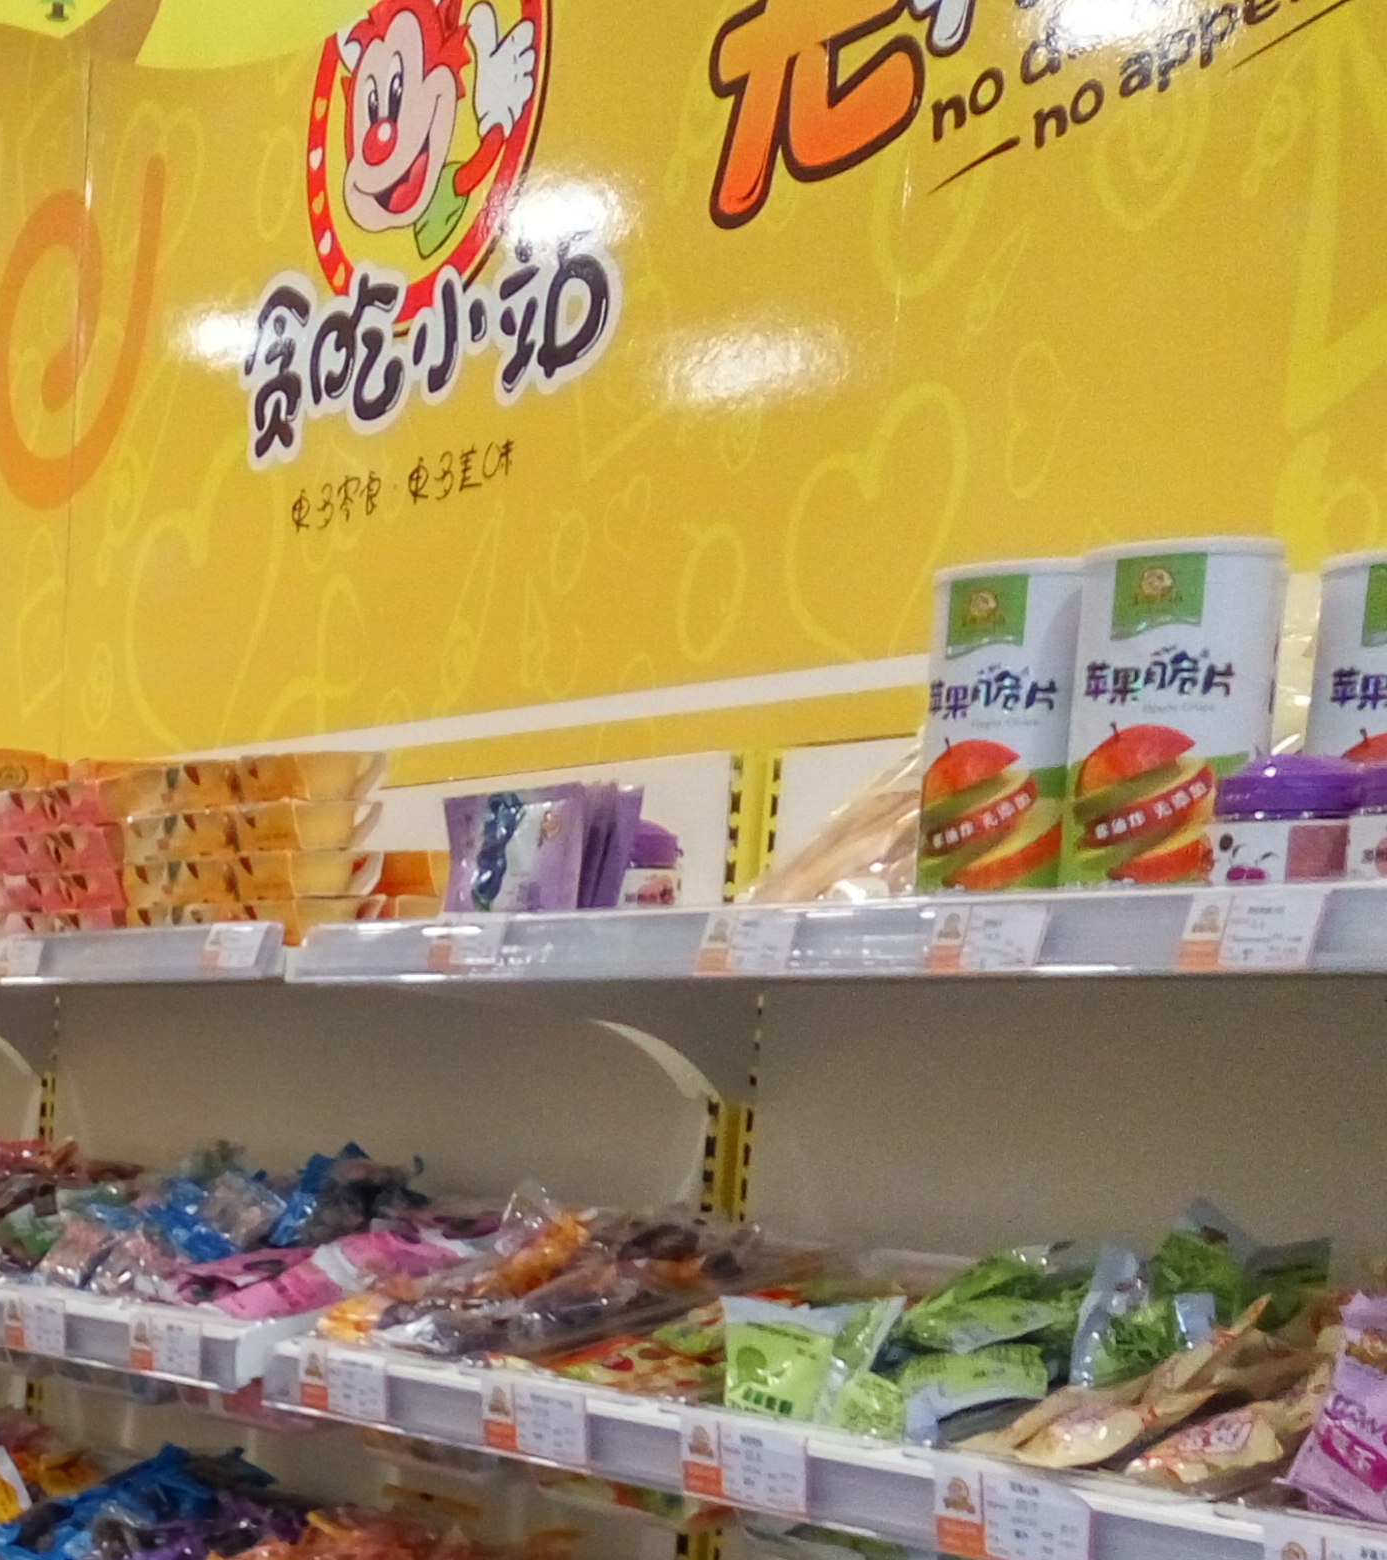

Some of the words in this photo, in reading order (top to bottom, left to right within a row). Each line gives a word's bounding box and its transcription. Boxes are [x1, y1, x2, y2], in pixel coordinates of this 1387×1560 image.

[931, 67, 1004, 142] no
[1034, 79, 1105, 148] no
[1120, 0, 1287, 97] appe
[244, 232, 609, 458] 贪吃小站
